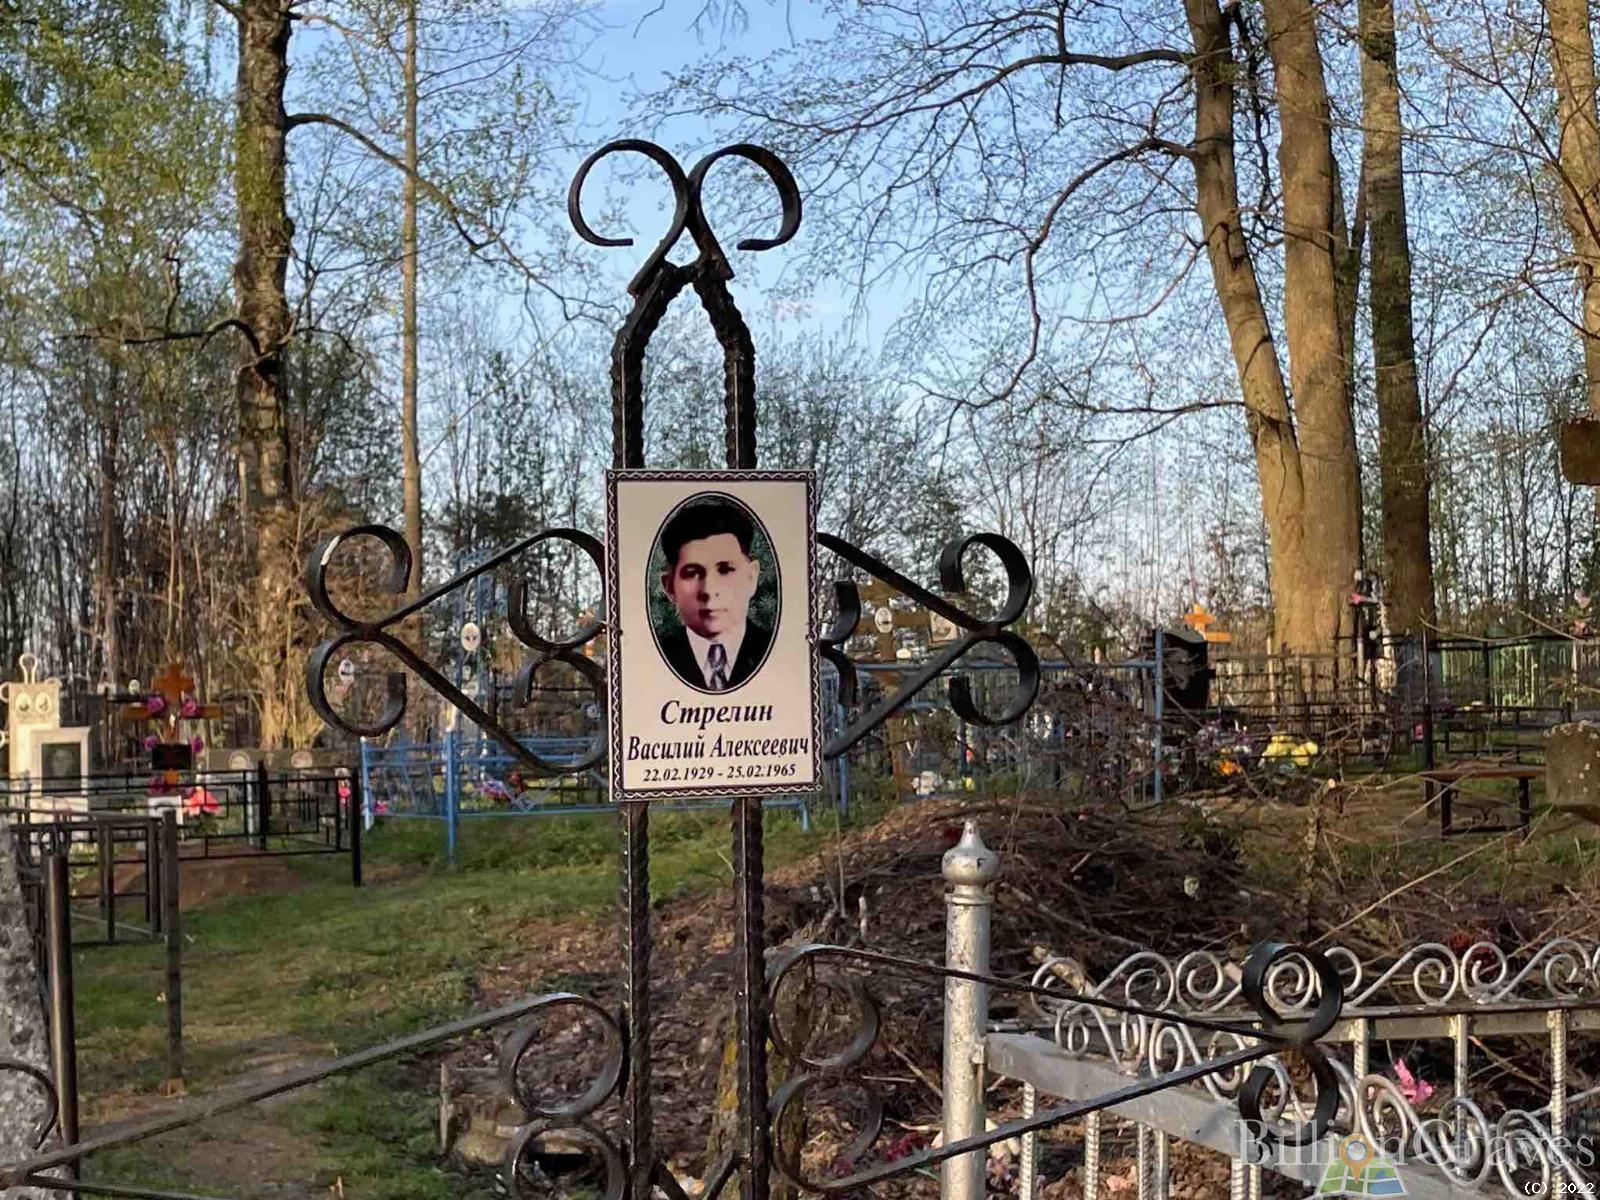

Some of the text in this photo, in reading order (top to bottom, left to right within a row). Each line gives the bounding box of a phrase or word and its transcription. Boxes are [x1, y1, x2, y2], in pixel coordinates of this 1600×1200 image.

[660, 700, 773, 730] Стрелин
[627, 733, 809, 761] Василий Алексеевич
[643, 767, 715, 782] 22.02.1929
[727, 763, 796, 779] 25.02.1965
